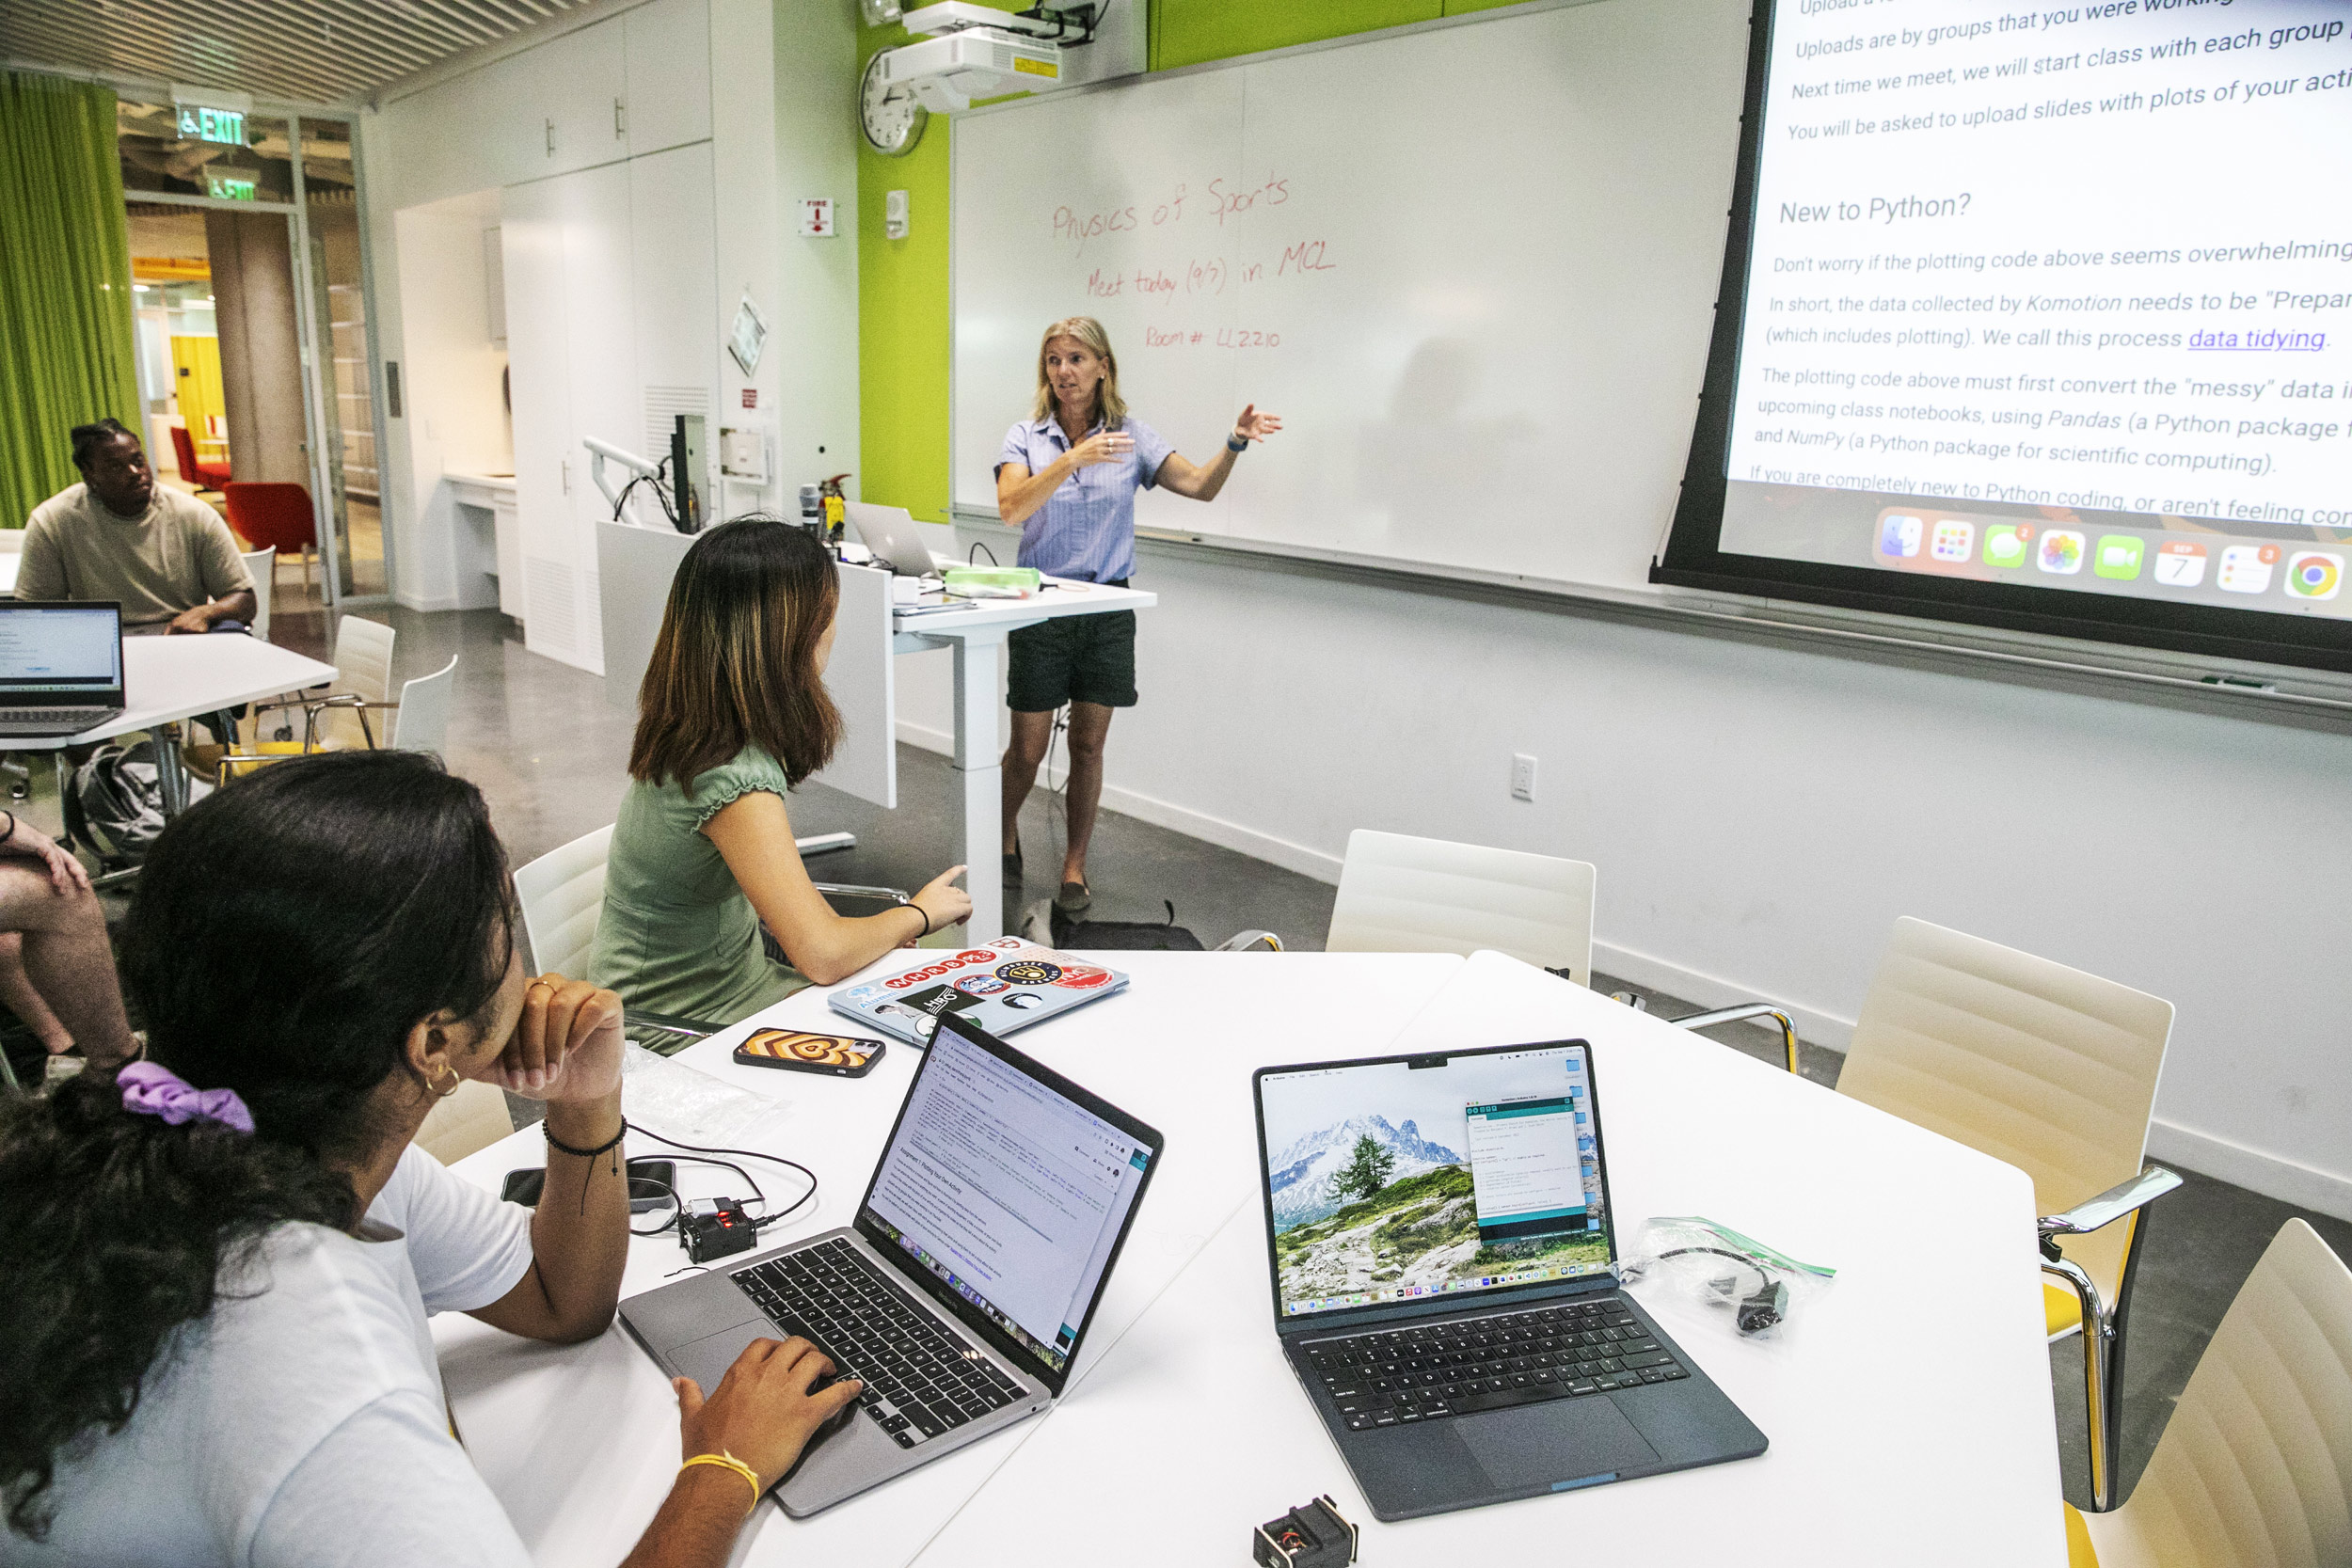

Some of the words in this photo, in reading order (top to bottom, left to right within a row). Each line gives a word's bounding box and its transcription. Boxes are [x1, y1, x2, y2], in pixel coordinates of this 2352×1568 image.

[1796, 35, 1865, 60] Uploads
[1869, 34, 1898, 49] are
[1902, 28, 1924, 47] by
[1928, 21, 1994, 45] groups
[1998, 12, 2038, 32] that
[2042, 8, 2080, 30] you
[2086, 0, 2138, 20] were
[1792, 83, 1830, 99] Next
[1835, 79, 1872, 94] time
[1877, 76, 1902, 90] we
[1907, 68, 1957, 87] meet,
[1963, 67, 1991, 80] we
[1996, 57, 2028, 77] will
[2034, 53, 2081, 74] start
[2088, 48, 2144, 67] class
[2151, 37, 2198, 59] with
[2204, 28, 2263, 53] each
[2269, 21, 2344, 50] group
[199, 107, 244, 145] EXIT
[1788, 125, 1819, 139] You
[1823, 119, 1851, 136] will
[1855, 119, 1877, 135] be
[1882, 112, 1934, 133] asked
[1939, 113, 1958, 127] to
[1963, 103, 2028, 128] upload
[2034, 99, 2093, 119] slides
[2100, 91, 2144, 112] with
[2150, 87, 2206, 112] plots
[2214, 80, 2241, 101] of
[2243, 79, 2300, 103] your
[1053, 205, 1137, 259] Physics
[1152, 183, 1187, 226] of
[1208, 170, 1289, 226] Sports
[1780, 202, 1832, 223] New
[1838, 201, 1862, 220] to
[1869, 193, 1972, 224] Python?
[1088, 268, 1124, 297] Meet
[1135, 270, 1177, 306] today
[1186, 257, 1227, 296] (9/7)
[1242, 262, 1263, 283] in
[1279, 240, 1336, 277] MCL
[1774, 257, 1814, 272] Don't
[1819, 260, 1865, 275] worry
[1868, 254, 1882, 270] if
[1885, 254, 1913, 270] the
[1916, 253, 1986, 273] plotting
[1992, 250, 2039, 267] code
[2043, 249, 2105, 266] above
[2110, 250, 2182, 264] seems
[2188, 240, 2352, 262] overwhelming
[1770, 297, 1785, 311] In
[1788, 296, 1833, 313] short,
[1838, 296, 1865, 311] the
[1869, 295, 1907, 311] data
[1912, 295, 1995, 311] collected
[2000, 294, 2023, 315] by
[2026, 295, 2122, 311] Komotion
[2129, 293, 2194, 310] needs
[2201, 293, 2223, 309] to
[2230, 292, 2258, 309] be
[1145, 325, 1184, 347] Room
[1190, 331, 1204, 345] #
[1766, 326, 1819, 346] (which
[1823, 327, 1892, 343] includes
[1897, 327, 1976, 349] plotting).
[1983, 329, 2012, 345] We
[2017, 329, 2051, 345] call
[2057, 329, 2092, 346] this
[2098, 333, 2183, 350] process
[2187, 329, 2240, 350] data
[2244, 329, 2330, 352] tidying.
[1762, 368, 1791, 383] The
[1795, 369, 1856, 389] plotting
[1861, 372, 1903, 387] code
[1907, 372, 1961, 388] above
[1965, 376, 2013, 390] must
[2019, 374, 2056, 391] first
[2061, 379, 2138, 394] convert
[2144, 377, 2178, 395] the
[2185, 378, 2276, 402] "messy"
[2280, 380, 2334, 399] data
[1758, 401, 1837, 420] upcoming
[1841, 401, 1884, 418] class
[1889, 404, 1986, 425] notebooks,
[1992, 410, 2043, 429] using
[2048, 410, 2122, 429] Pandas
[2129, 412, 2149, 434] (a
[2155, 414, 2232, 436] Python
[2237, 417, 2340, 441] package
[1755, 429, 1784, 443] and
[1788, 430, 1846, 451] NumPy
[1849, 433, 1865, 451] (a
[1870, 435, 1930, 453] Python
[1934, 439, 2011, 460] package
[2017, 442, 2044, 459] for
[2049, 447, 2139, 465] scientific
[2145, 453, 2277, 476] computing).
[1750, 466, 1761, 480] If
[1765, 468, 1793, 483] you
[1796, 471, 1822, 485] are
[1825, 474, 1917, 495] completely
[1921, 482, 1959, 496] new
[1963, 482, 1980, 499] to
[1986, 483, 2051, 504] Python
[2135, 497, 2157, 512] or
[2162, 498, 2221, 516] aren't
[2021, 528, 2029, 539] 2
[2173, 545, 2193, 553] SEP
[2173, 558, 2188, 578] 7
[2265, 549, 2275, 561] 3
[887, 960, 961, 988] WHRB
[962, 949, 991, 962] 95.3
